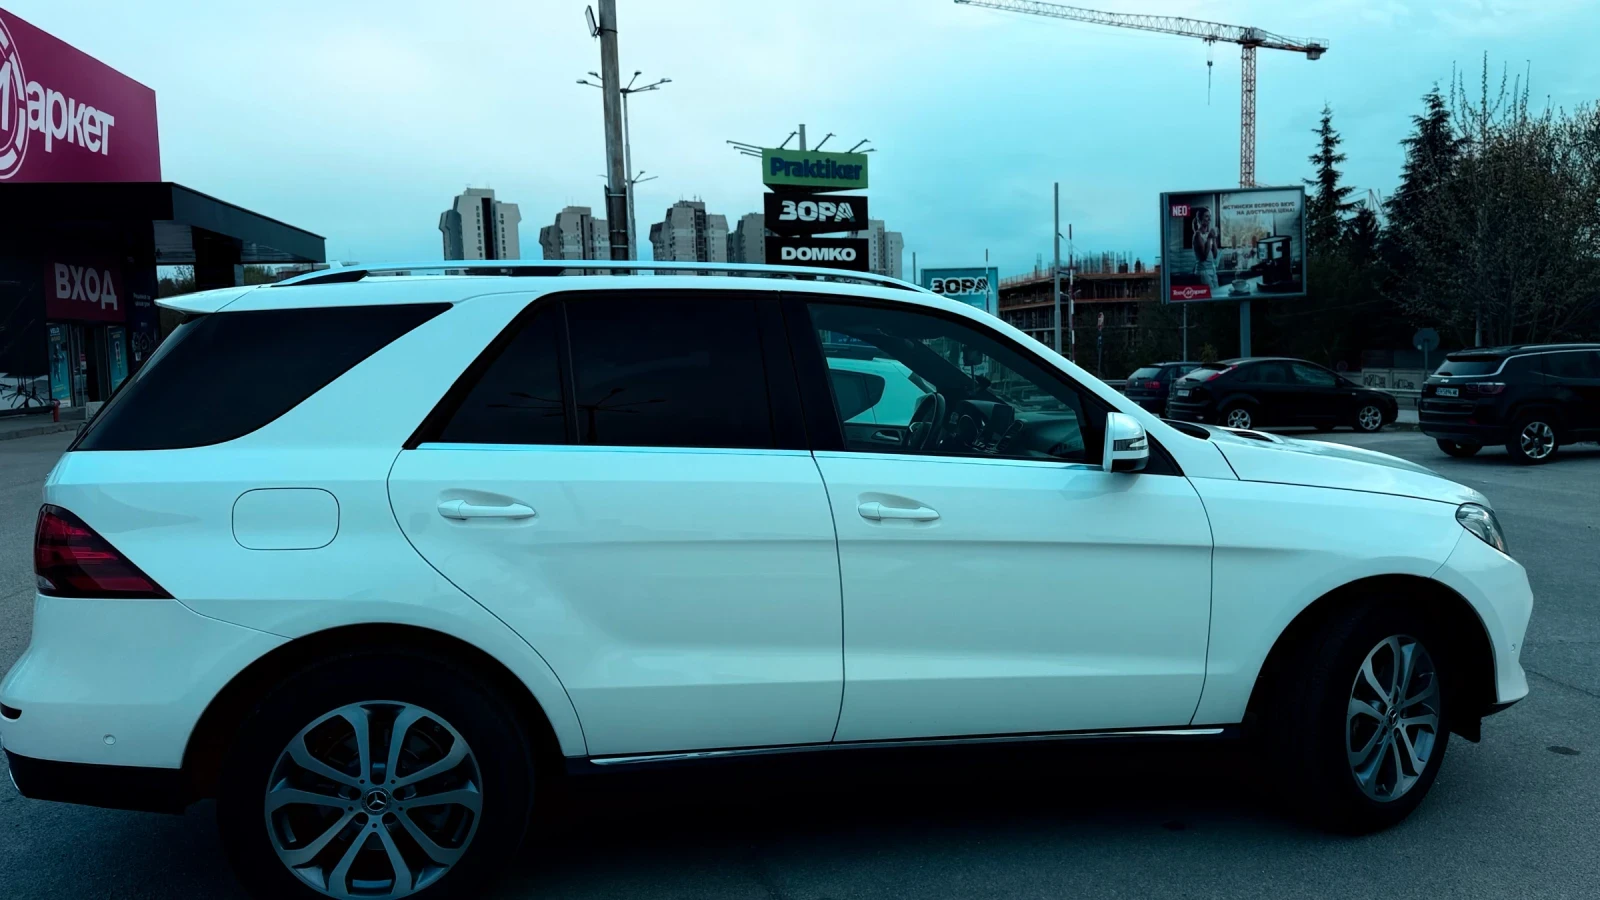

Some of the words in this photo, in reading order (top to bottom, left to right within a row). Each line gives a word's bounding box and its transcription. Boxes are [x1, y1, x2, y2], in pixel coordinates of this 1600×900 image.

[770, 157, 863, 181] Praktiker
[778, 200, 856, 223] ЗОРА
[1172, 204, 1188, 217] NEO
[781, 246, 857, 262] DOMKO
[54, 262, 119, 311] ВХОД
[930, 277, 994, 296] ЗОРА
